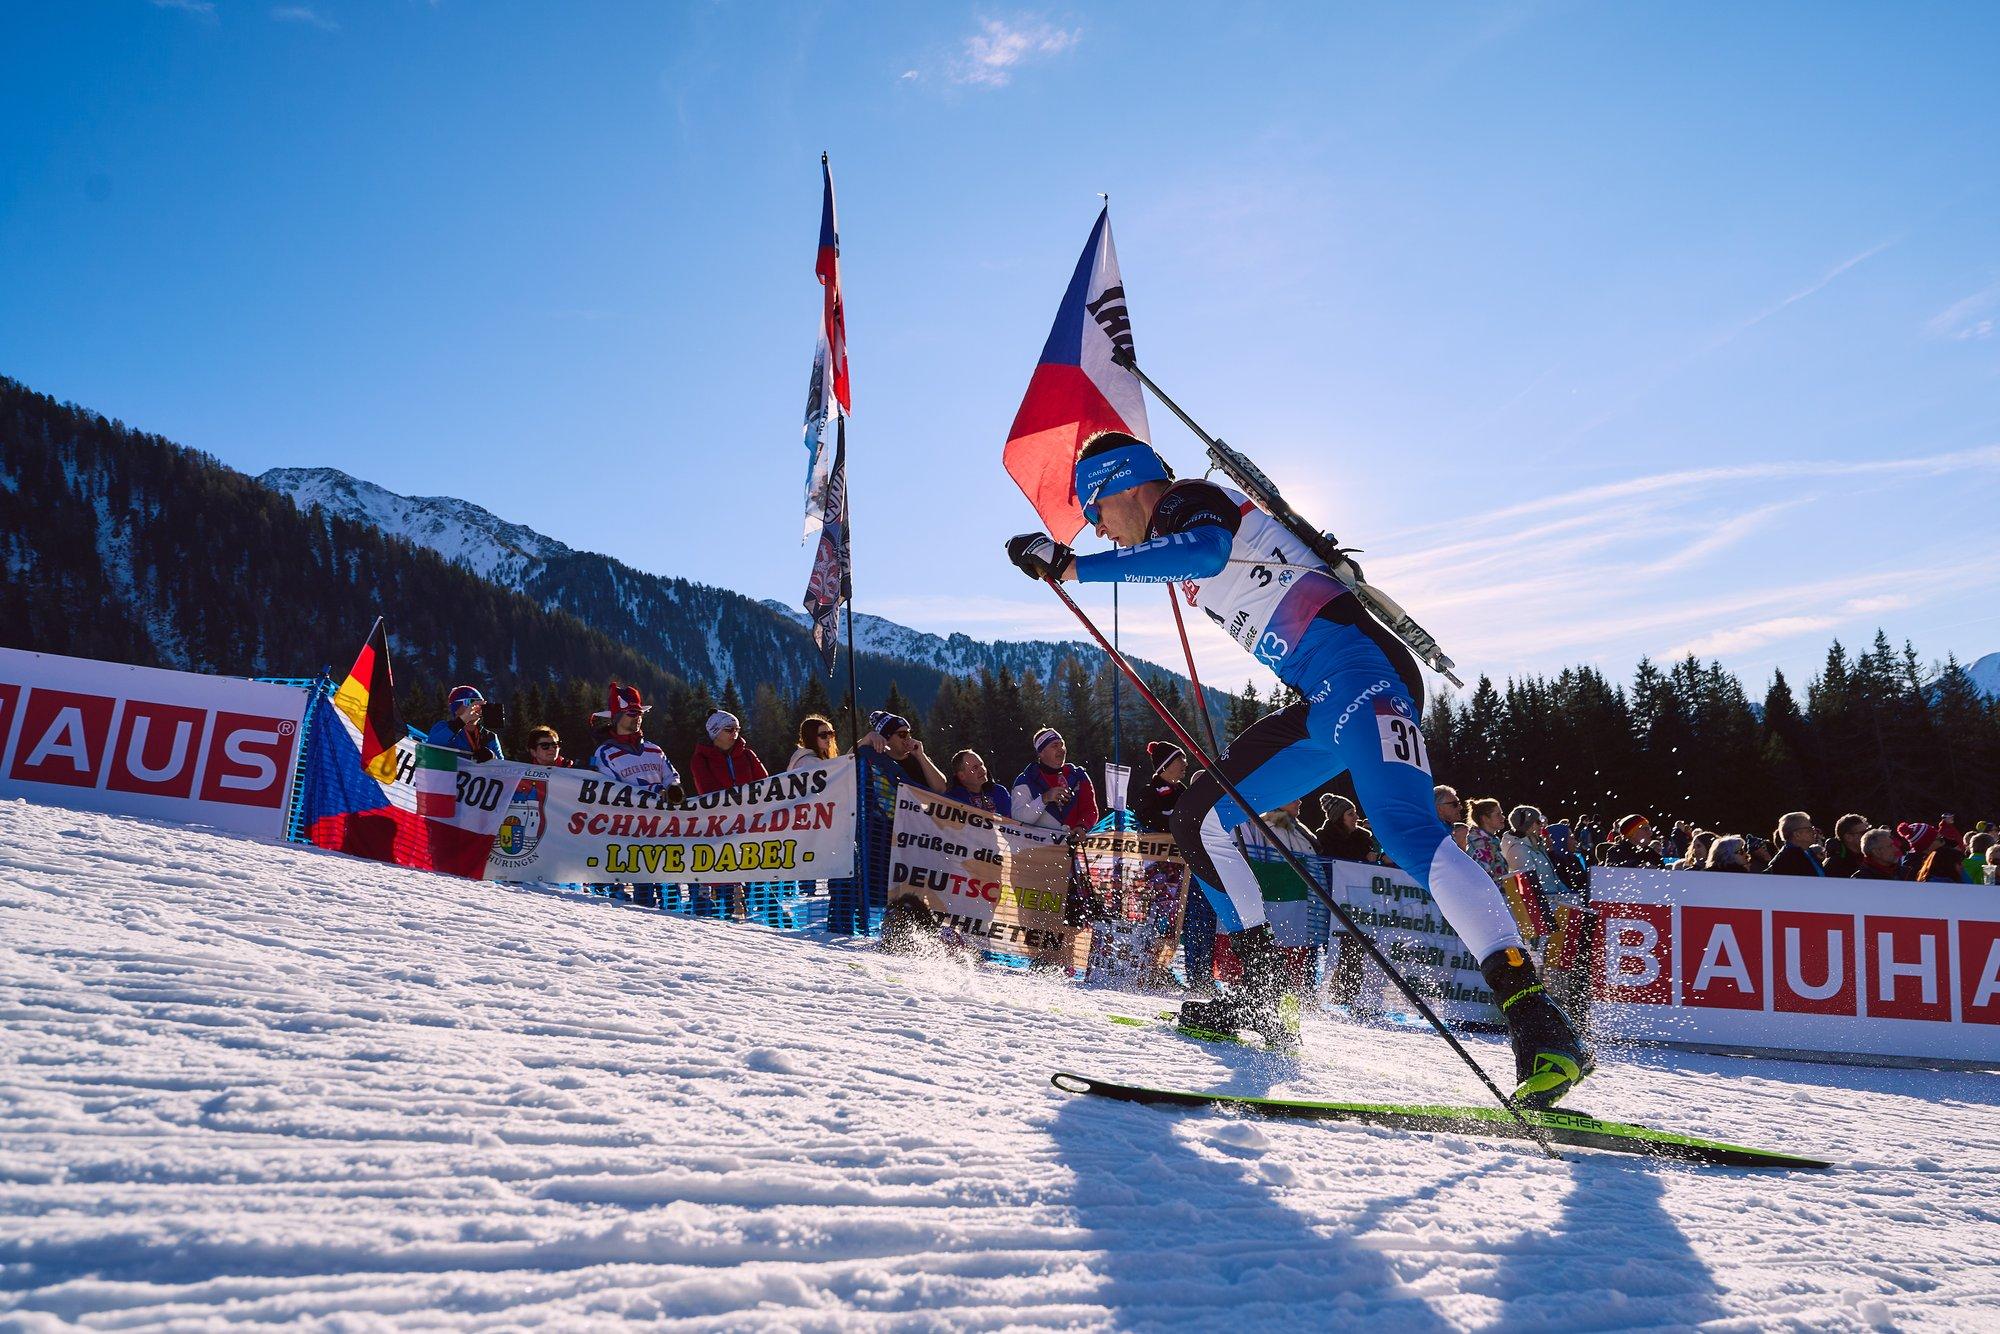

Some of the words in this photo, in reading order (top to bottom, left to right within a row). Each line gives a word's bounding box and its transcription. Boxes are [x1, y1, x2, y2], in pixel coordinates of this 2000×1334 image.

[1333, 679, 1391, 745] moomoo
[1390, 719, 1421, 768] 31
[568, 801, 835, 838] SCHMALKALDEN
[899, 799, 921, 813] Die
[923, 802, 995, 830] JUNGS
[998, 825, 1021, 837] aus
[1023, 831, 1047, 843] der
[605, 843, 685, 873] LIVE
[690, 839, 798, 872] DABEI
[897, 831, 968, 858] grüßen
[973, 848, 1004, 866] die
[893, 862, 1062, 913] DEUTSCHEN
[932, 910, 1065, 950] THLETEN
